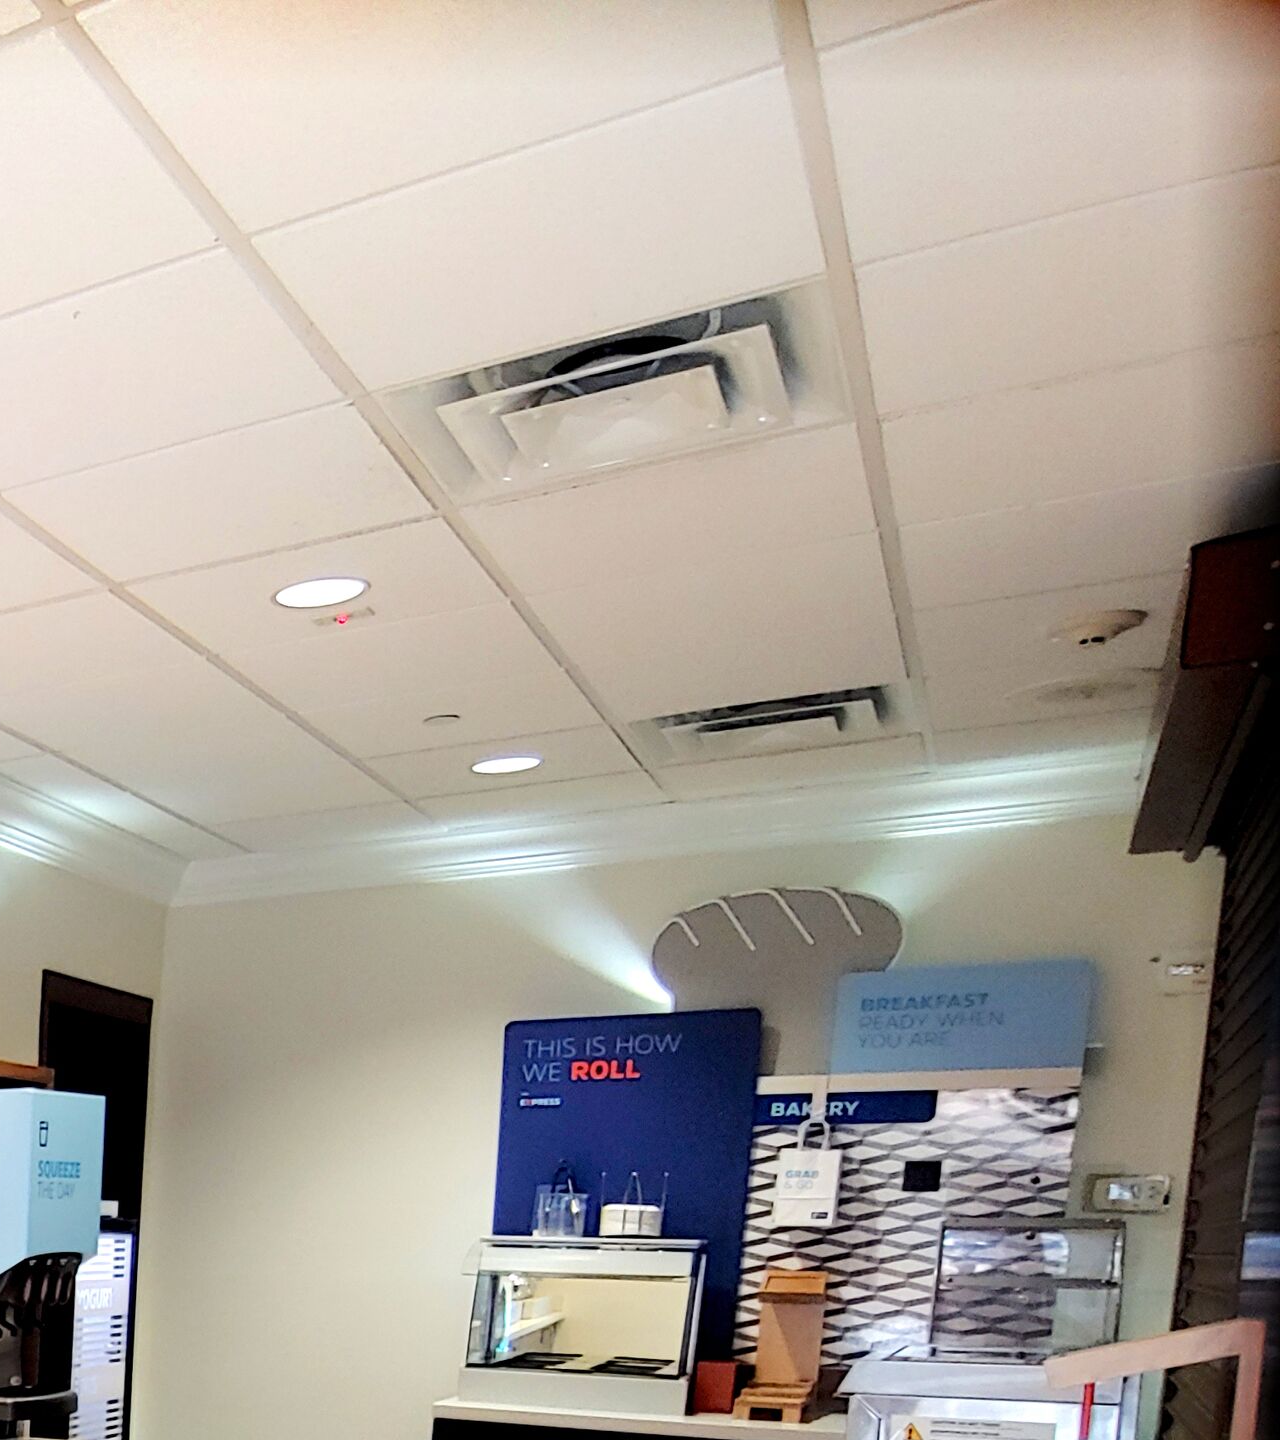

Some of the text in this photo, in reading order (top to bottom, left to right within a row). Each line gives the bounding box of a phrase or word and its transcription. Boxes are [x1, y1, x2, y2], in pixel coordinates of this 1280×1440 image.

[860, 993, 988, 1012] BREAKFAST
[858, 1011, 1004, 1031] READY WHEN
[523, 1033, 682, 1059] THIS IS HOW
[858, 1030, 950, 1049] YOU ARE
[522, 1059, 641, 1082] WE ROLL
[770, 1101, 860, 1117] BAKRY
[37, 1160, 81, 1179] SQUEEZE
[785, 1170, 819, 1179] GRAB
[76, 1287, 113, 1310] YOGURT
